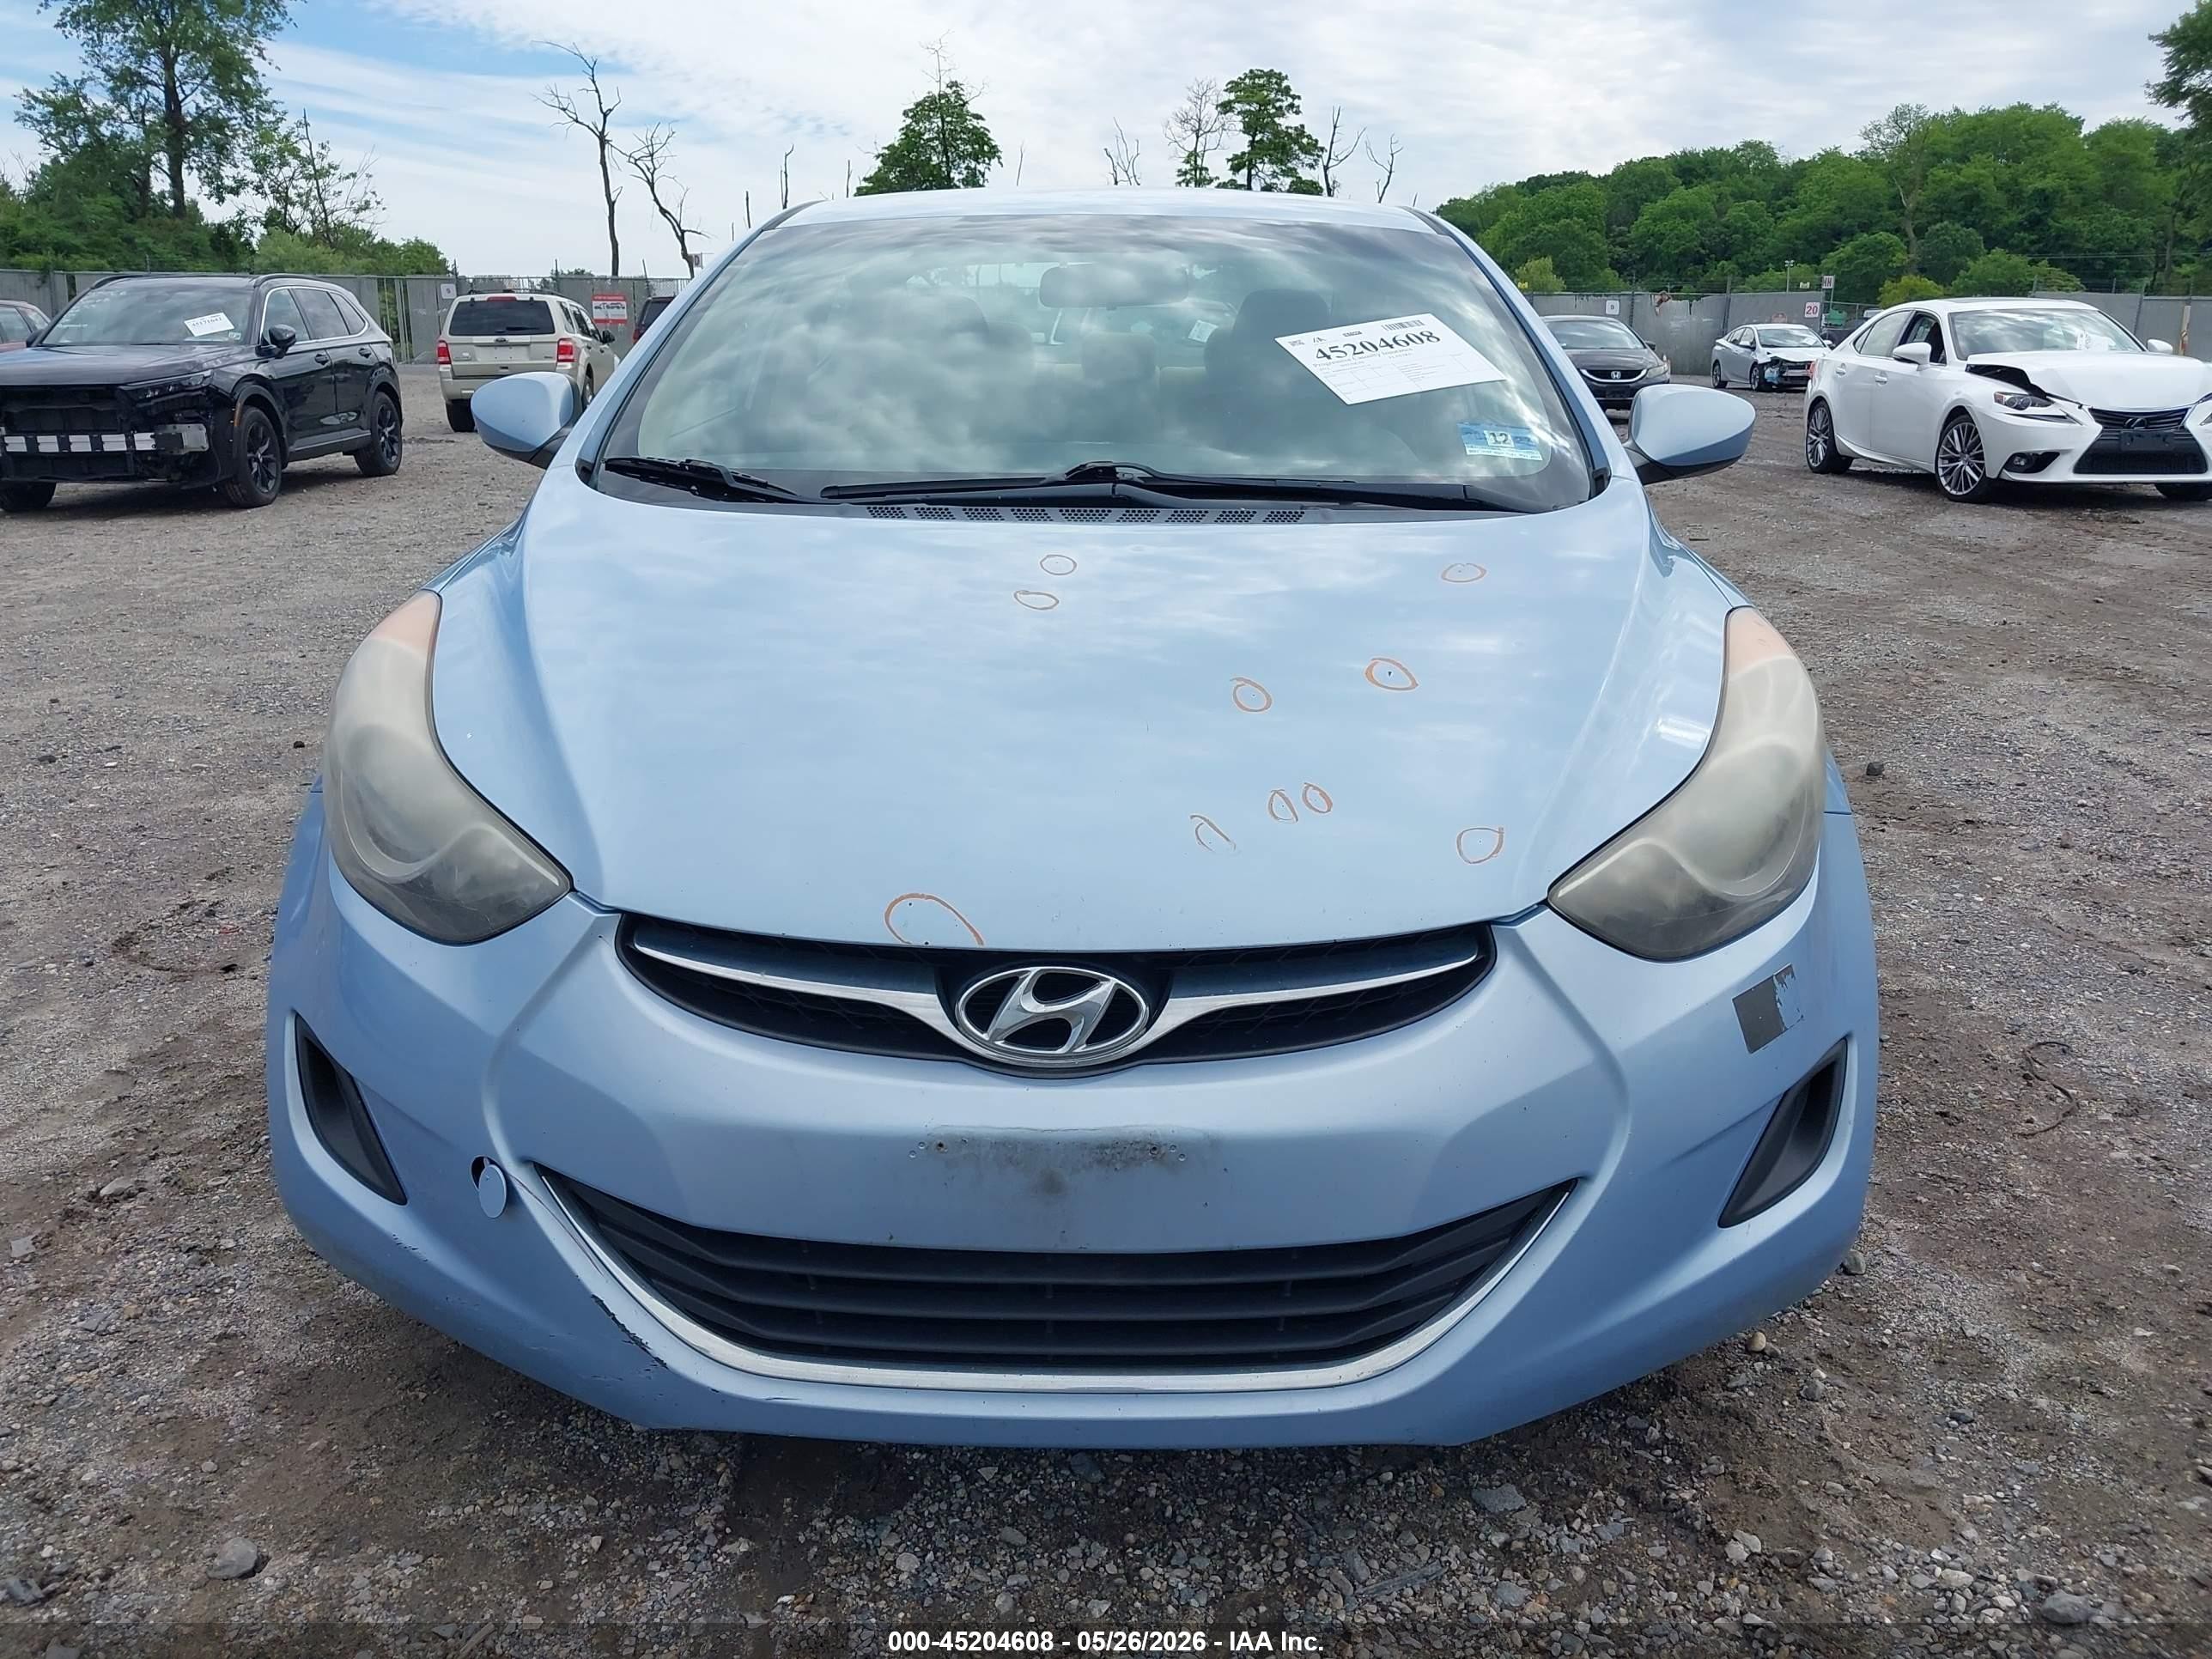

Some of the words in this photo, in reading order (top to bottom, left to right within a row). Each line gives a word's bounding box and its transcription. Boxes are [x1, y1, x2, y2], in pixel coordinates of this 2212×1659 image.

[1806, 306, 1818, 315] 20
[1316, 331, 1441, 361] 45204608
[1489, 432, 1511, 446] 12
